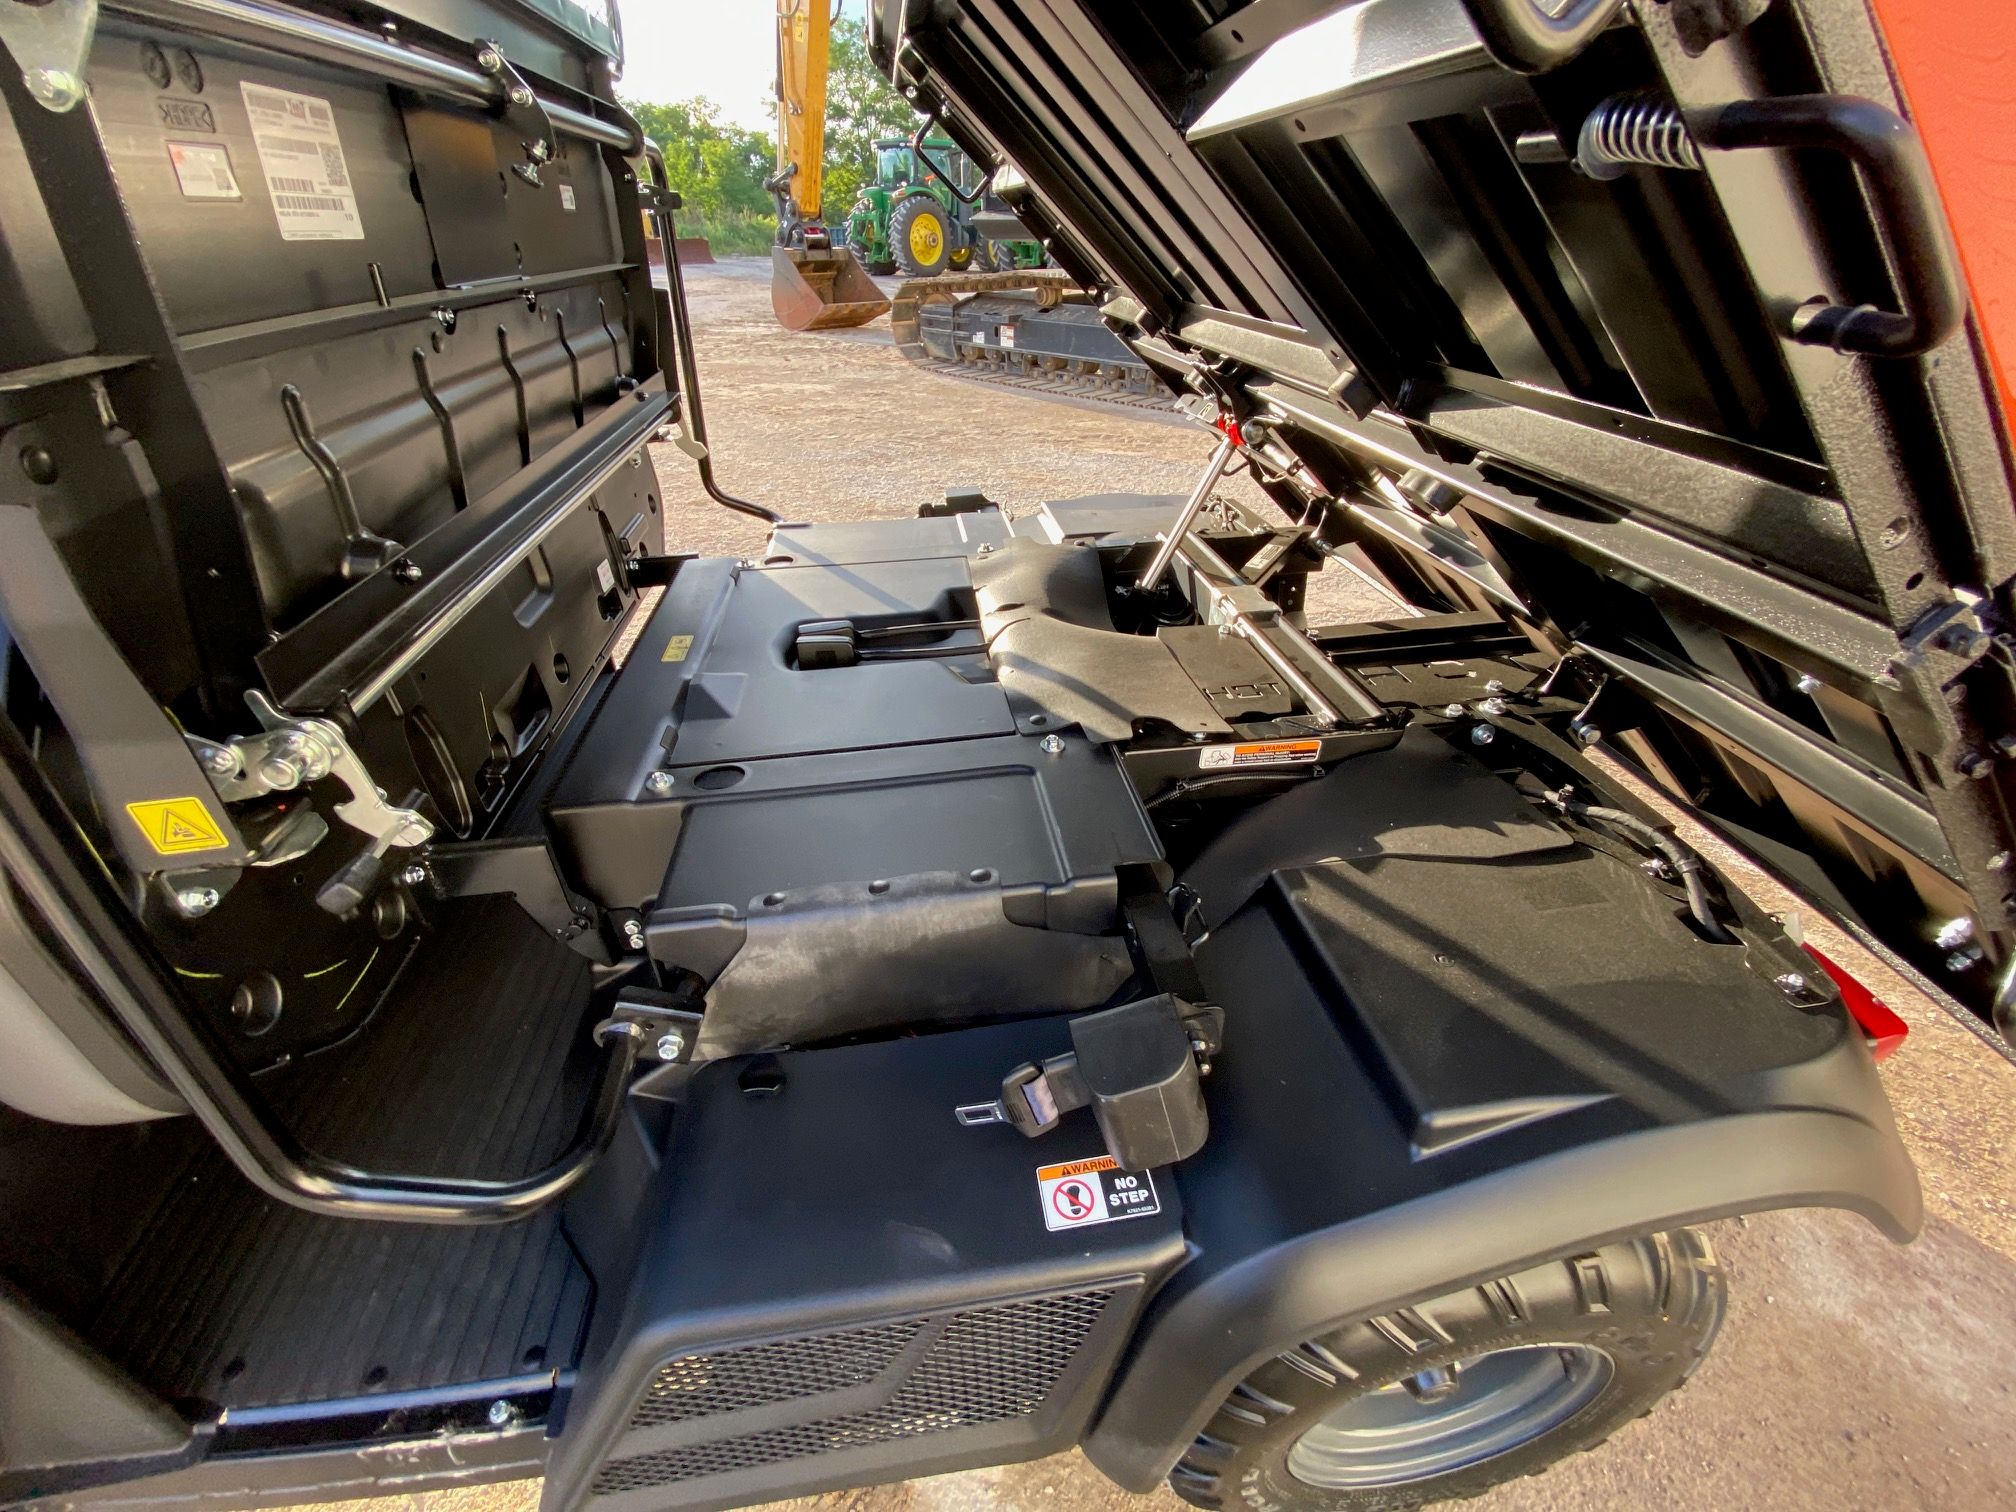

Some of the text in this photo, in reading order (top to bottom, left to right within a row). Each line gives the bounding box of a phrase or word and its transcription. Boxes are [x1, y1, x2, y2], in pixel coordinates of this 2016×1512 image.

[1202, 682, 1282, 701] HOT
[1265, 743, 1297, 751] WARNING
[1072, 1159, 1119, 1173] WARNIN
[1114, 1176, 1138, 1190] NO
[1109, 1189, 1149, 1206] STEP
